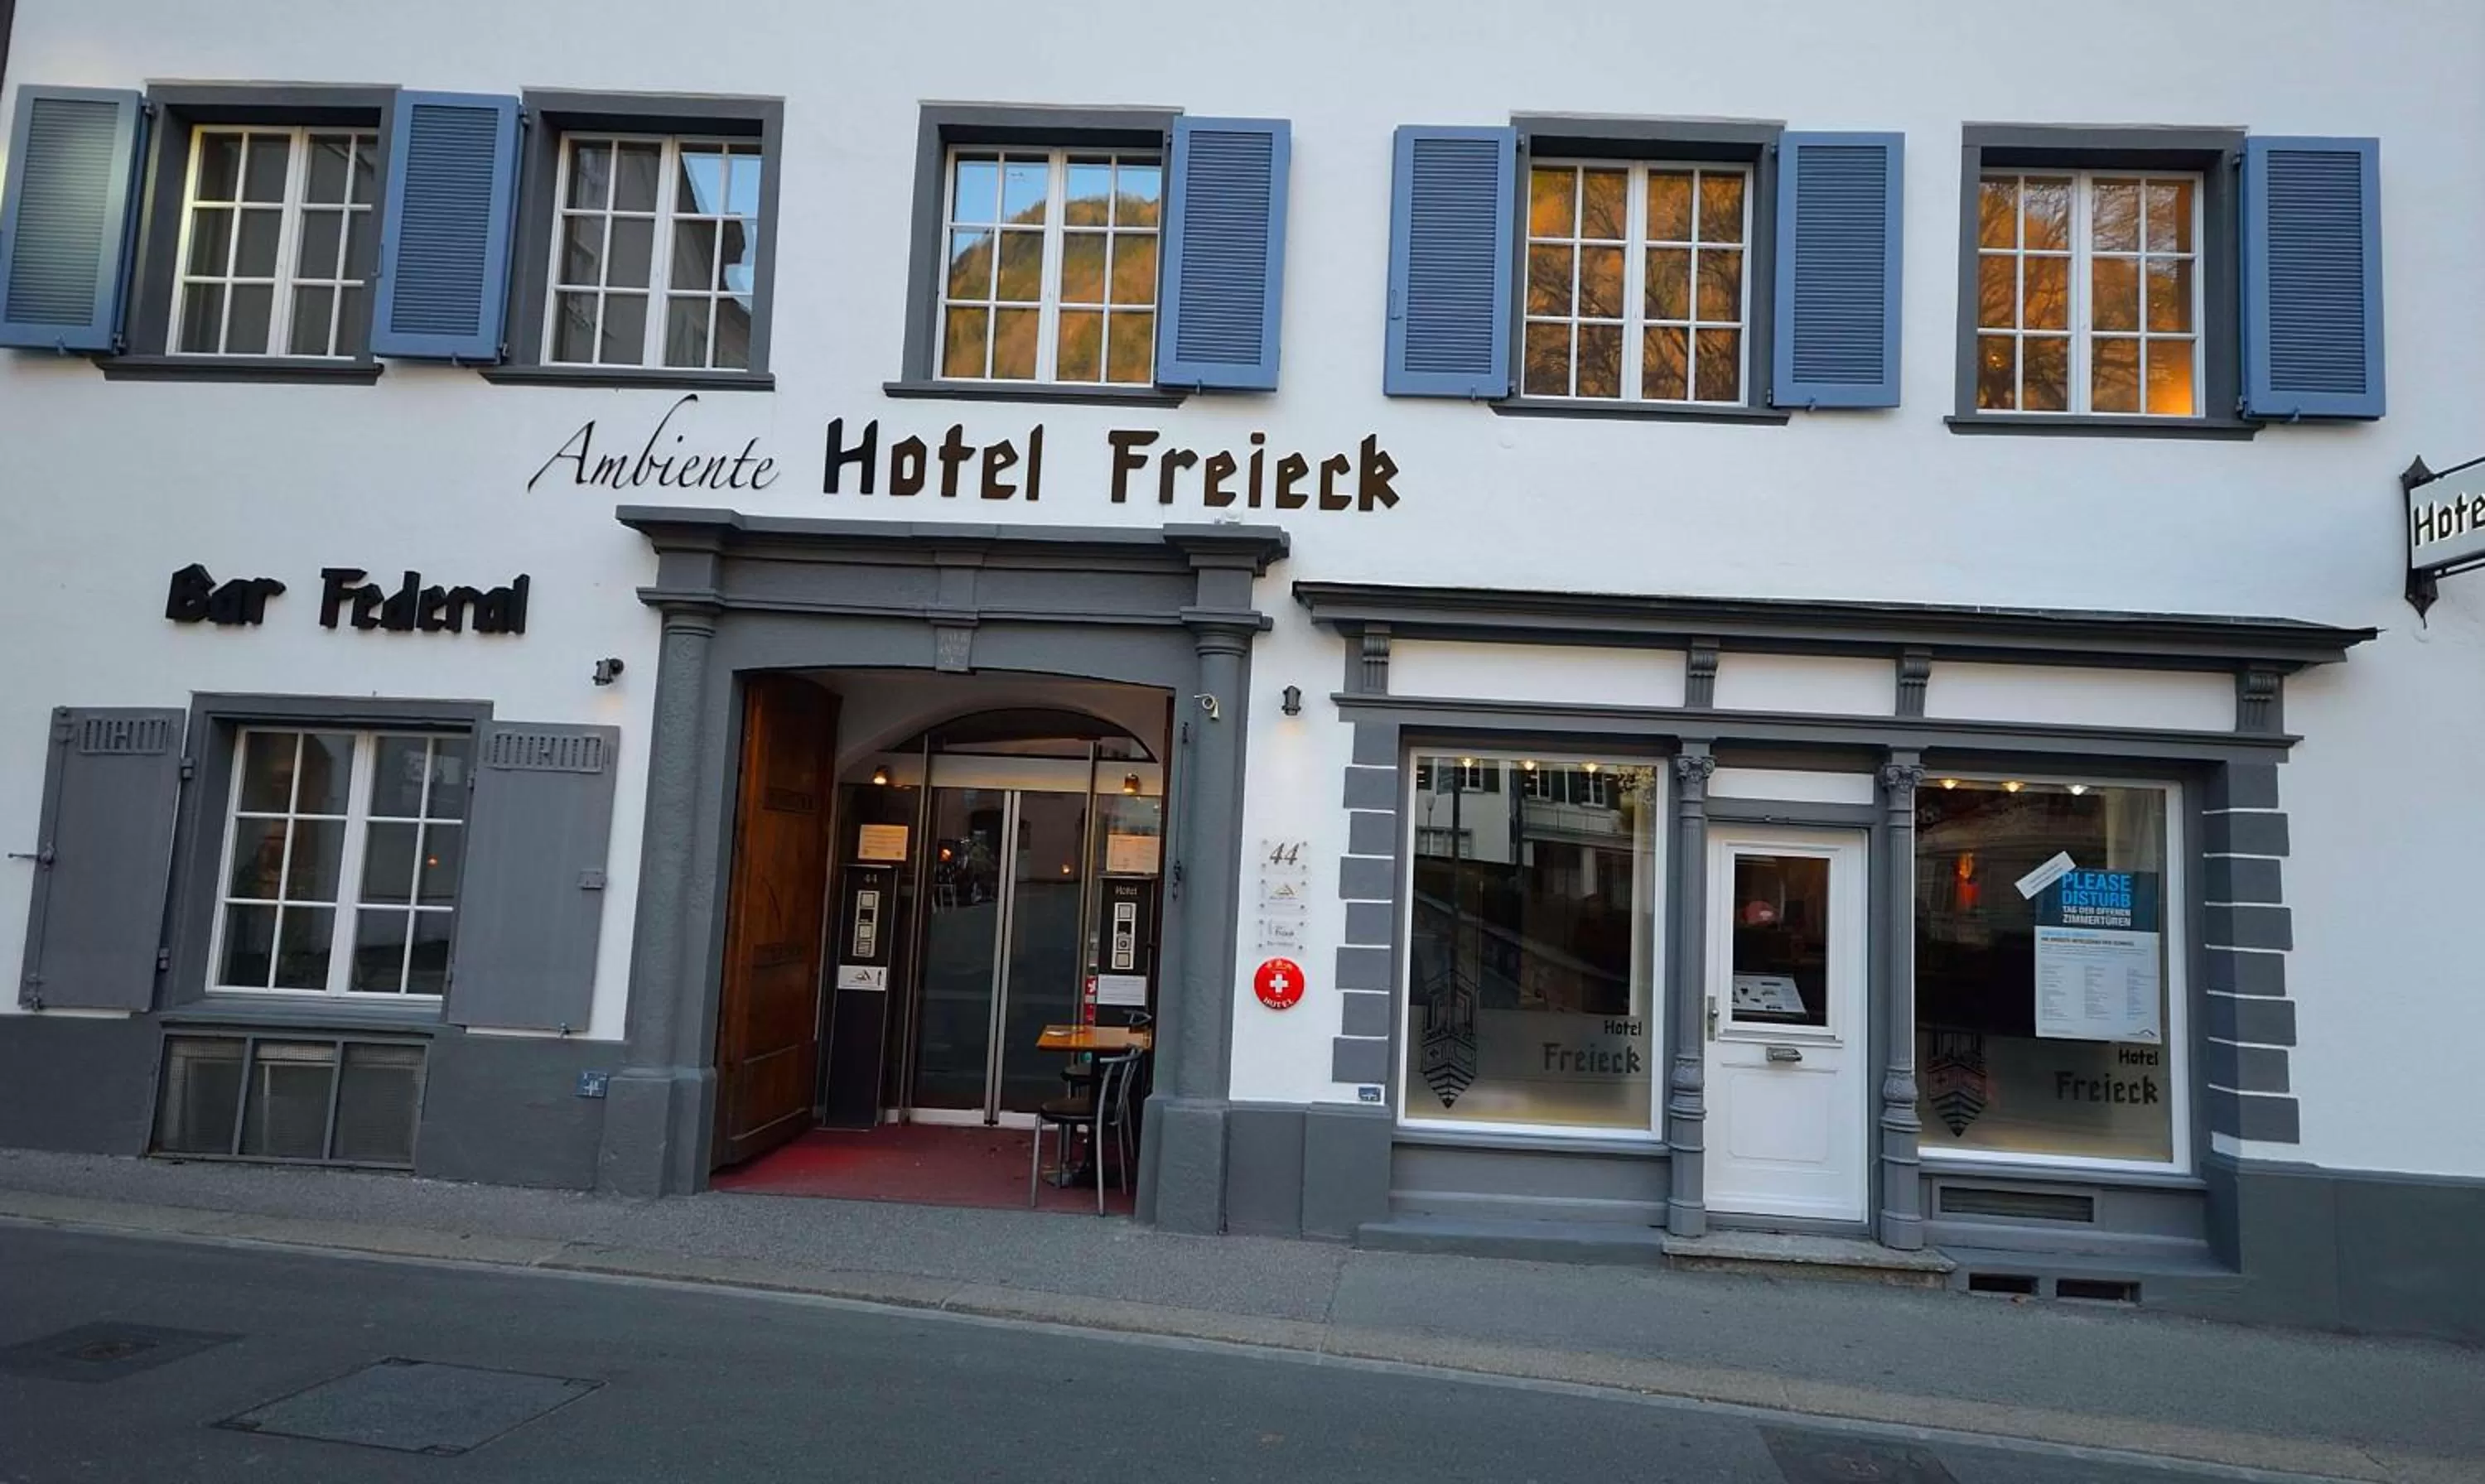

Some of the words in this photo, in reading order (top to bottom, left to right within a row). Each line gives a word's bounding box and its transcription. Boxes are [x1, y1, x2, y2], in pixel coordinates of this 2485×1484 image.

[527, 393, 780, 492] Ambiente
[823, 417, 1044, 501] Hotel
[1107, 430, 1401, 512] Freieck
[166, 563, 287, 625] Bar
[319, 568, 530, 635] Federal
[1269, 842, 1299, 865] 44
[2062, 872, 2131, 892] PLEASE
[2062, 890, 2131, 908] DISTURB
[1263, 996, 1293, 1008] HOTEL
[1604, 1019, 1643, 1036] Hotel
[1542, 1042, 1642, 1074] Freieck
[2119, 1048, 2159, 1066] Hotel
[2054, 1071, 2158, 1104] Freieck
